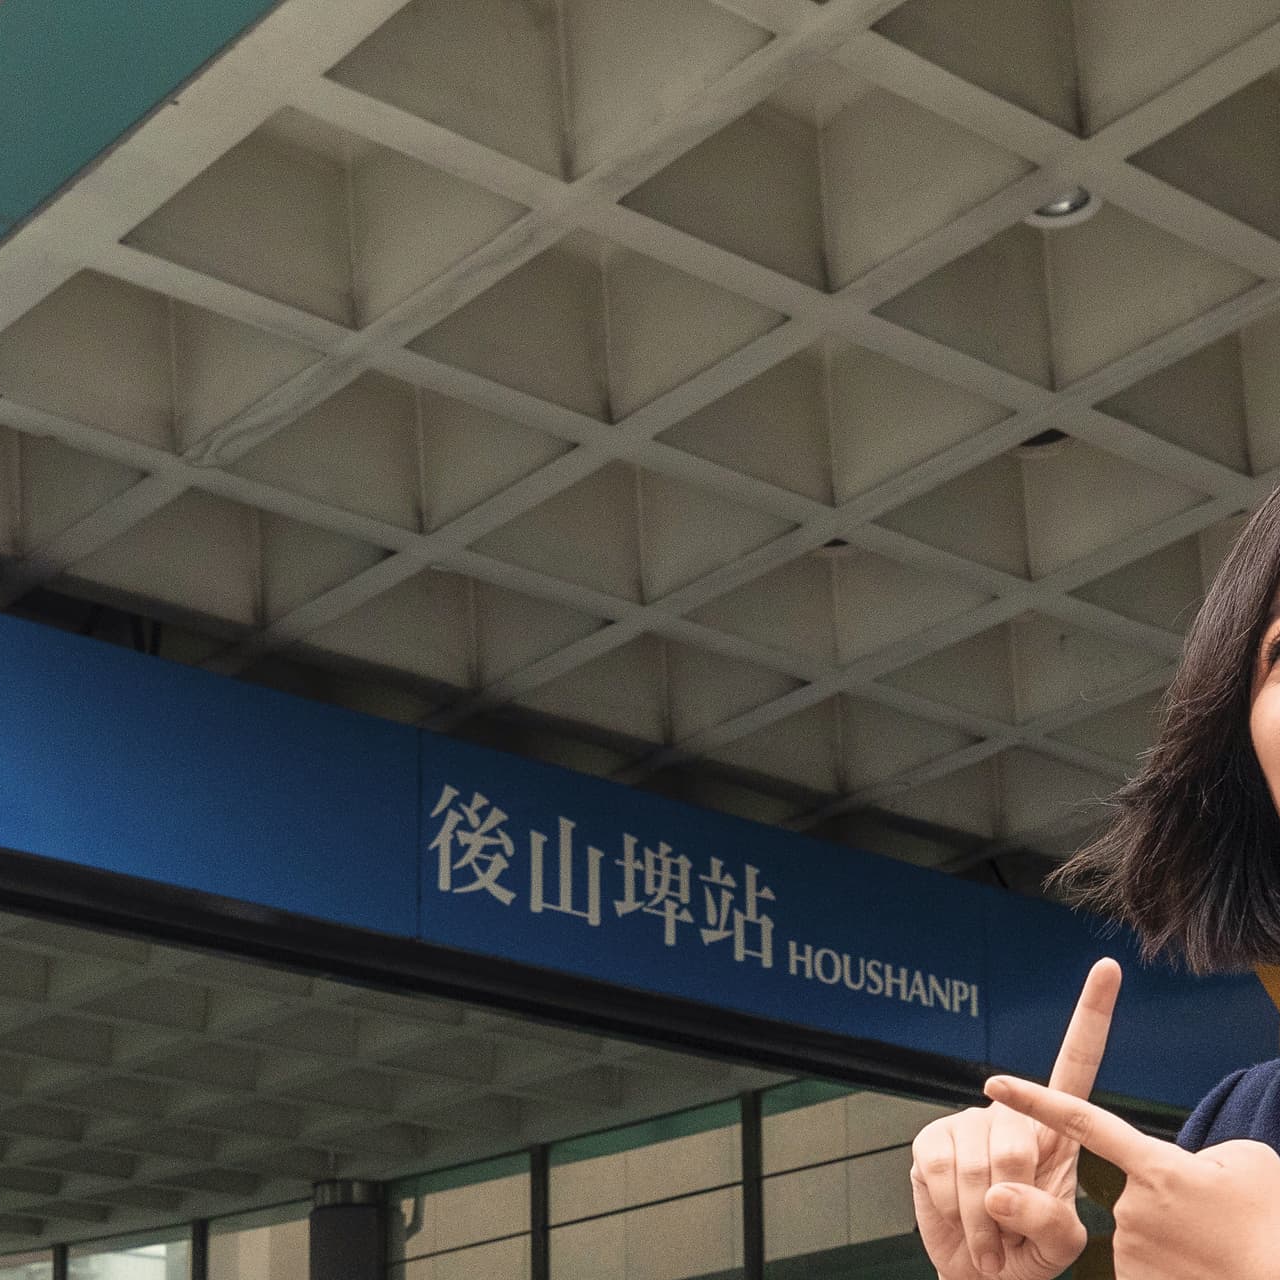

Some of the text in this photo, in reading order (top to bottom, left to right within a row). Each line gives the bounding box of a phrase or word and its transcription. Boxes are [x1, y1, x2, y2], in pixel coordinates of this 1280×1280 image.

[428, 784, 777, 969] 後山埤站
[788, 939, 980, 1018] HOUSHANPI
